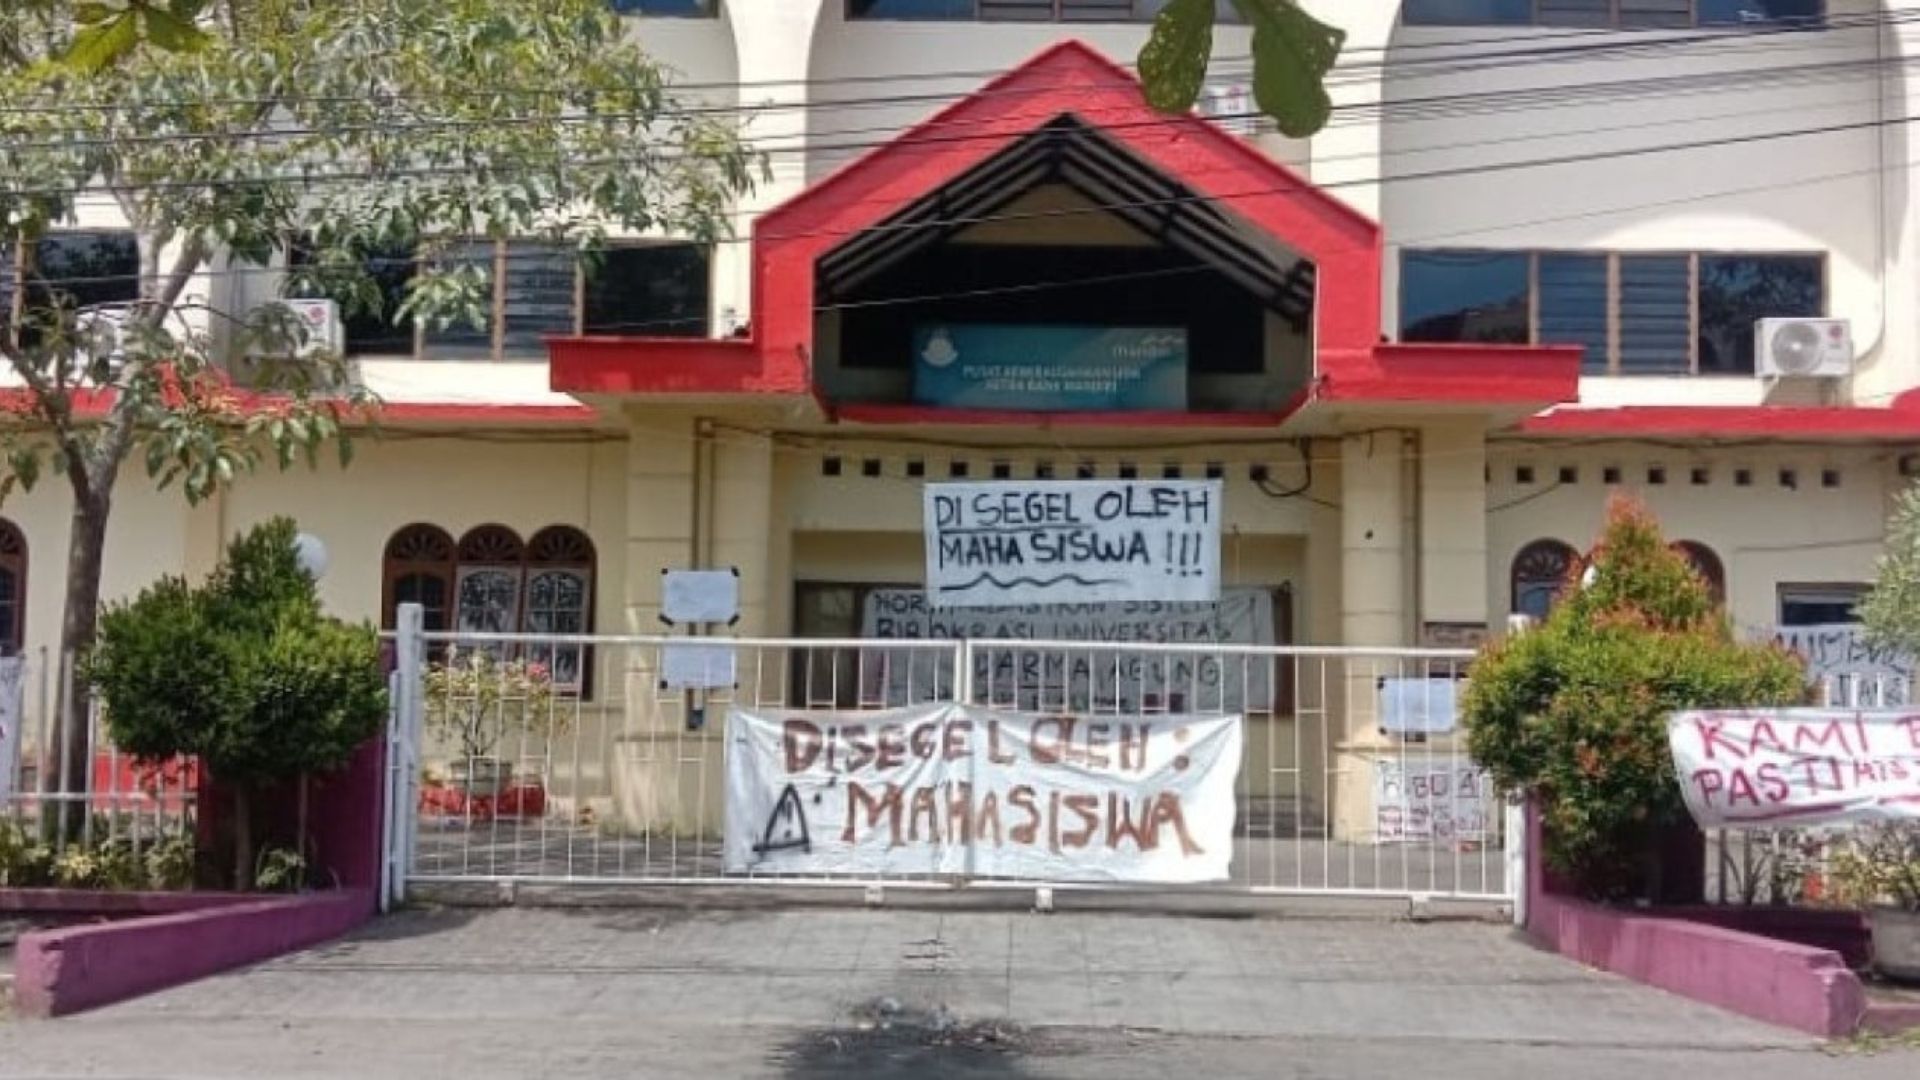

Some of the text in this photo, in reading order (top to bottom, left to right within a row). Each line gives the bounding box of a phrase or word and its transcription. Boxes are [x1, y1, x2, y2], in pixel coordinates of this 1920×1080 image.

[935, 486, 1209, 528] DI SEGEL OLEH
[974, 649, 1222, 687] DARMA AGUNG
[1030, 717, 1148, 773] OLEH
[1694, 711, 1868, 759] KAMI
[841, 780, 1202, 856] MAHASISWA
